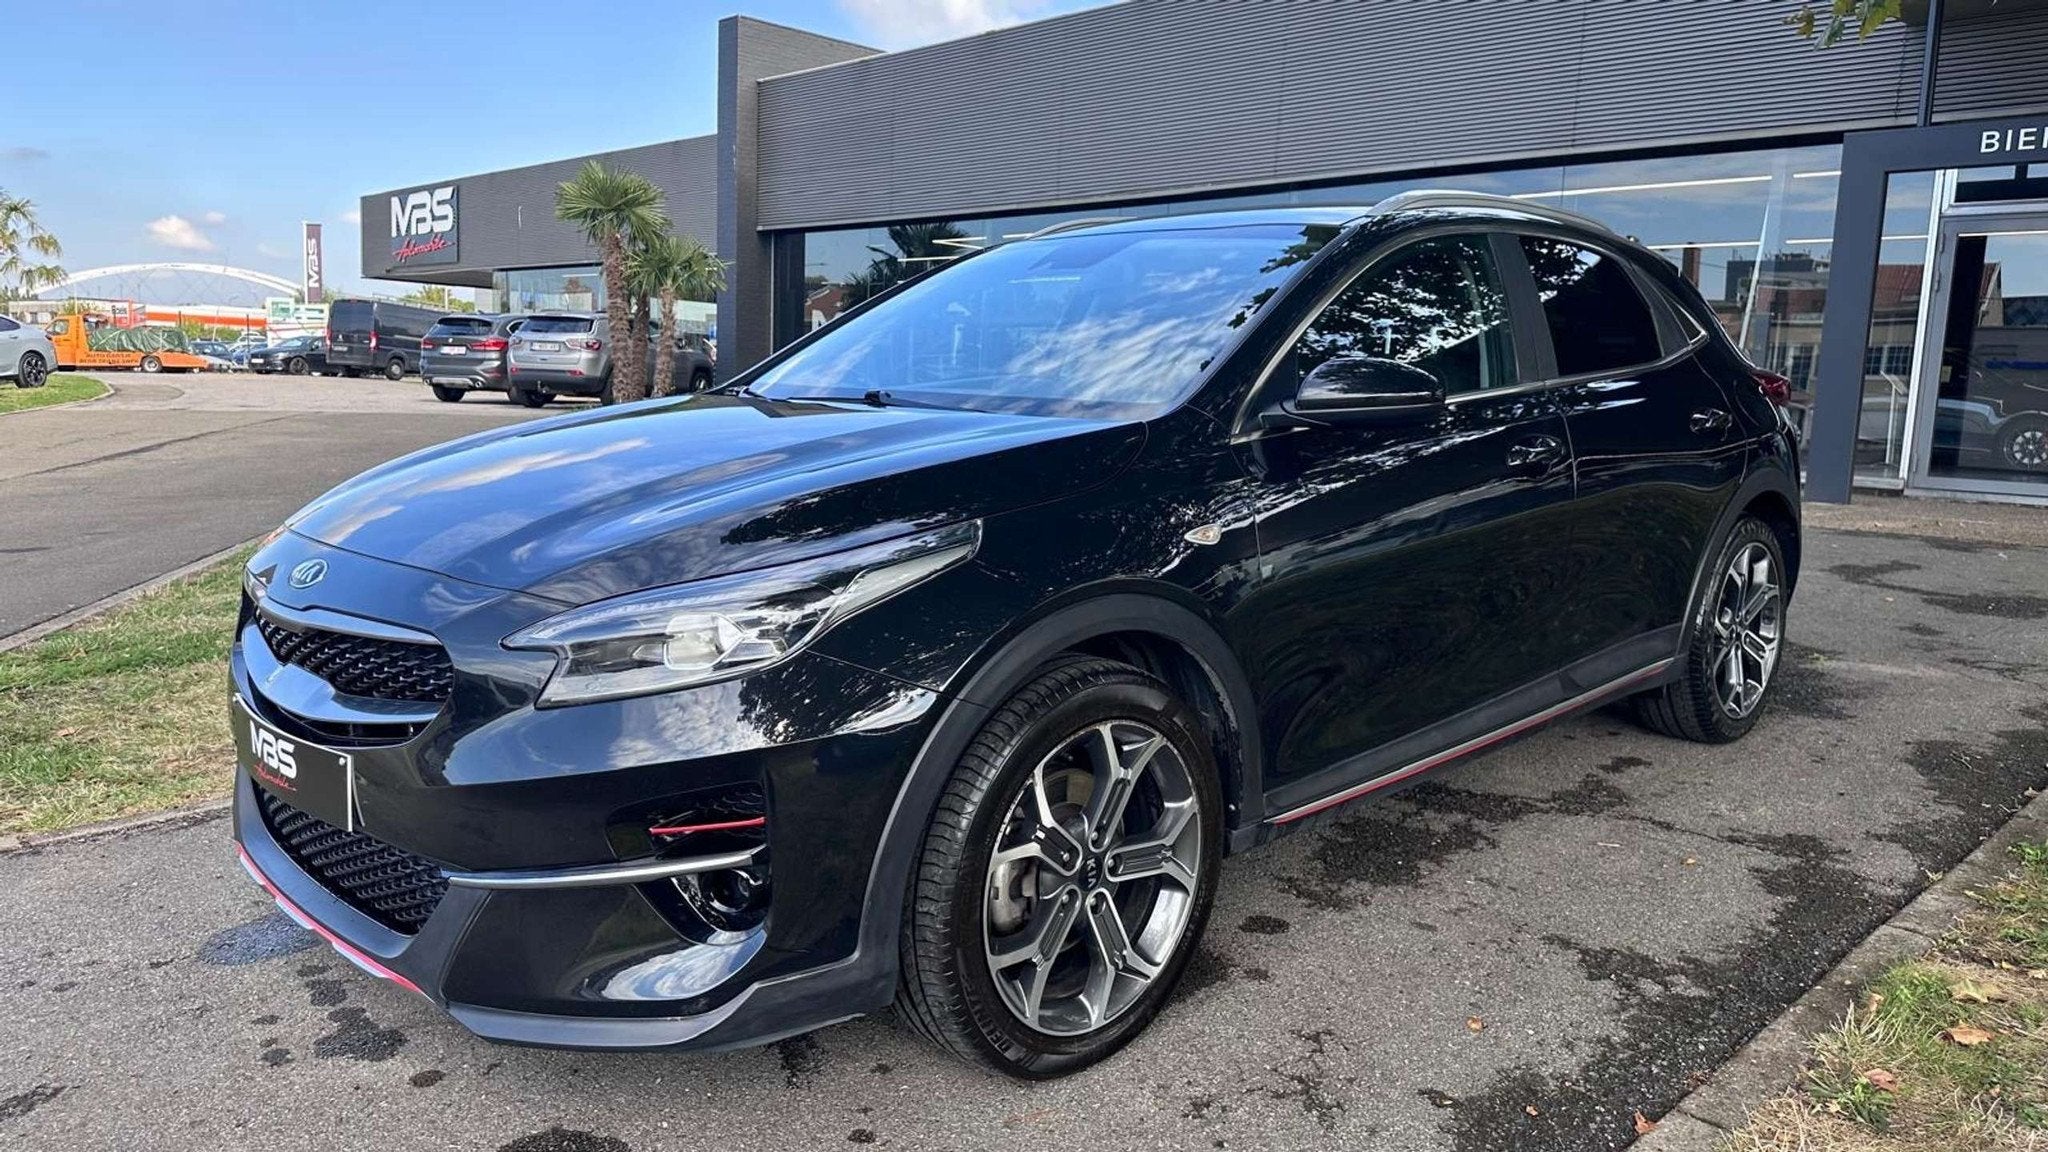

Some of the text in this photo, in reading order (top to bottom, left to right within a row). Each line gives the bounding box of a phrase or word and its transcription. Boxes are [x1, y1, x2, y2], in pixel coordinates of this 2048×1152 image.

[390, 186, 455, 238] MBS
[308, 238, 320, 288] MBS
[249, 719, 297, 779] MBS
[1086, 858, 1097, 888] KIA
